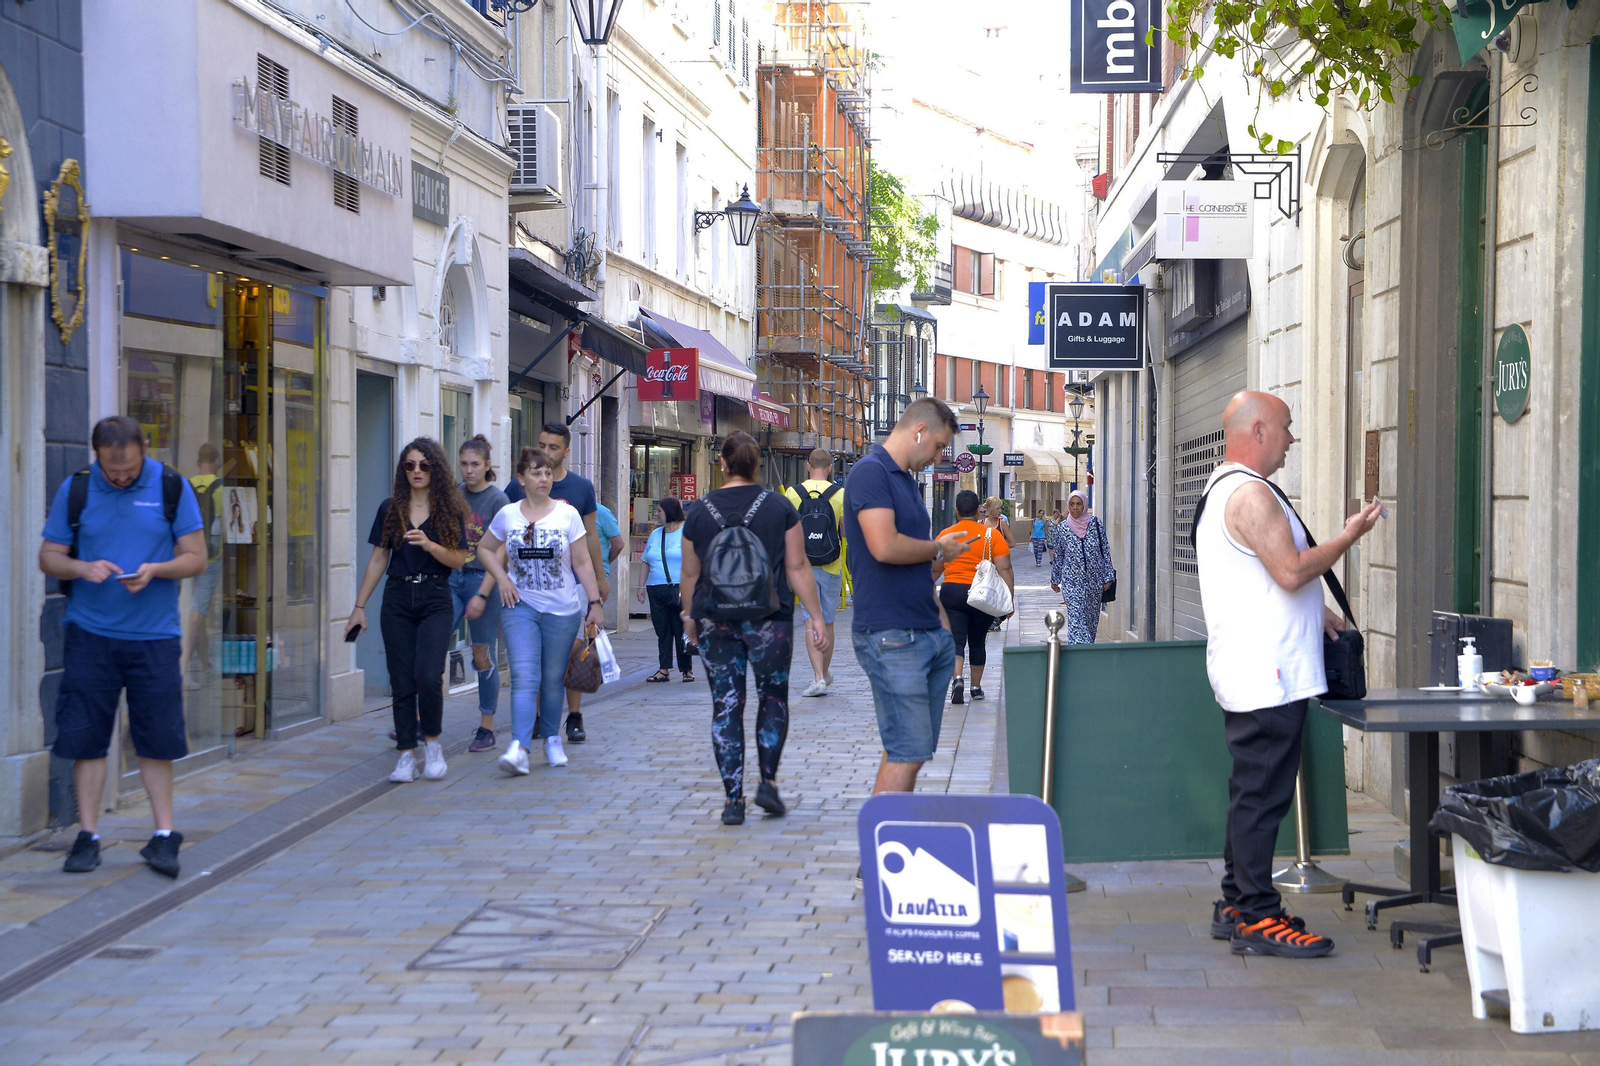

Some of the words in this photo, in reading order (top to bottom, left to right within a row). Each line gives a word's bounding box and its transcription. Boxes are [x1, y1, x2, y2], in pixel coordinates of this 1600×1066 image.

[413, 170, 445, 215] VENICE
[1198, 204, 1248, 213] CORNERSTONE
[1057, 312, 1136, 327] ADAM
[1067, 335, 1085, 343] Gifts
[1086, 335, 1093, 343] &
[1094, 335, 1126, 344] Luggage
[1496, 356, 1528, 396] JURY'S
[745, 490, 768, 517] KENDALL
[808, 532, 823, 540] AON
[898, 897, 968, 917] LAVAZZA
[887, 948, 945, 965] SERVED
[946, 951, 985, 967] HERE
[938, 1018, 971, 1038] Wine
[973, 1024, 1000, 1044] Bar
